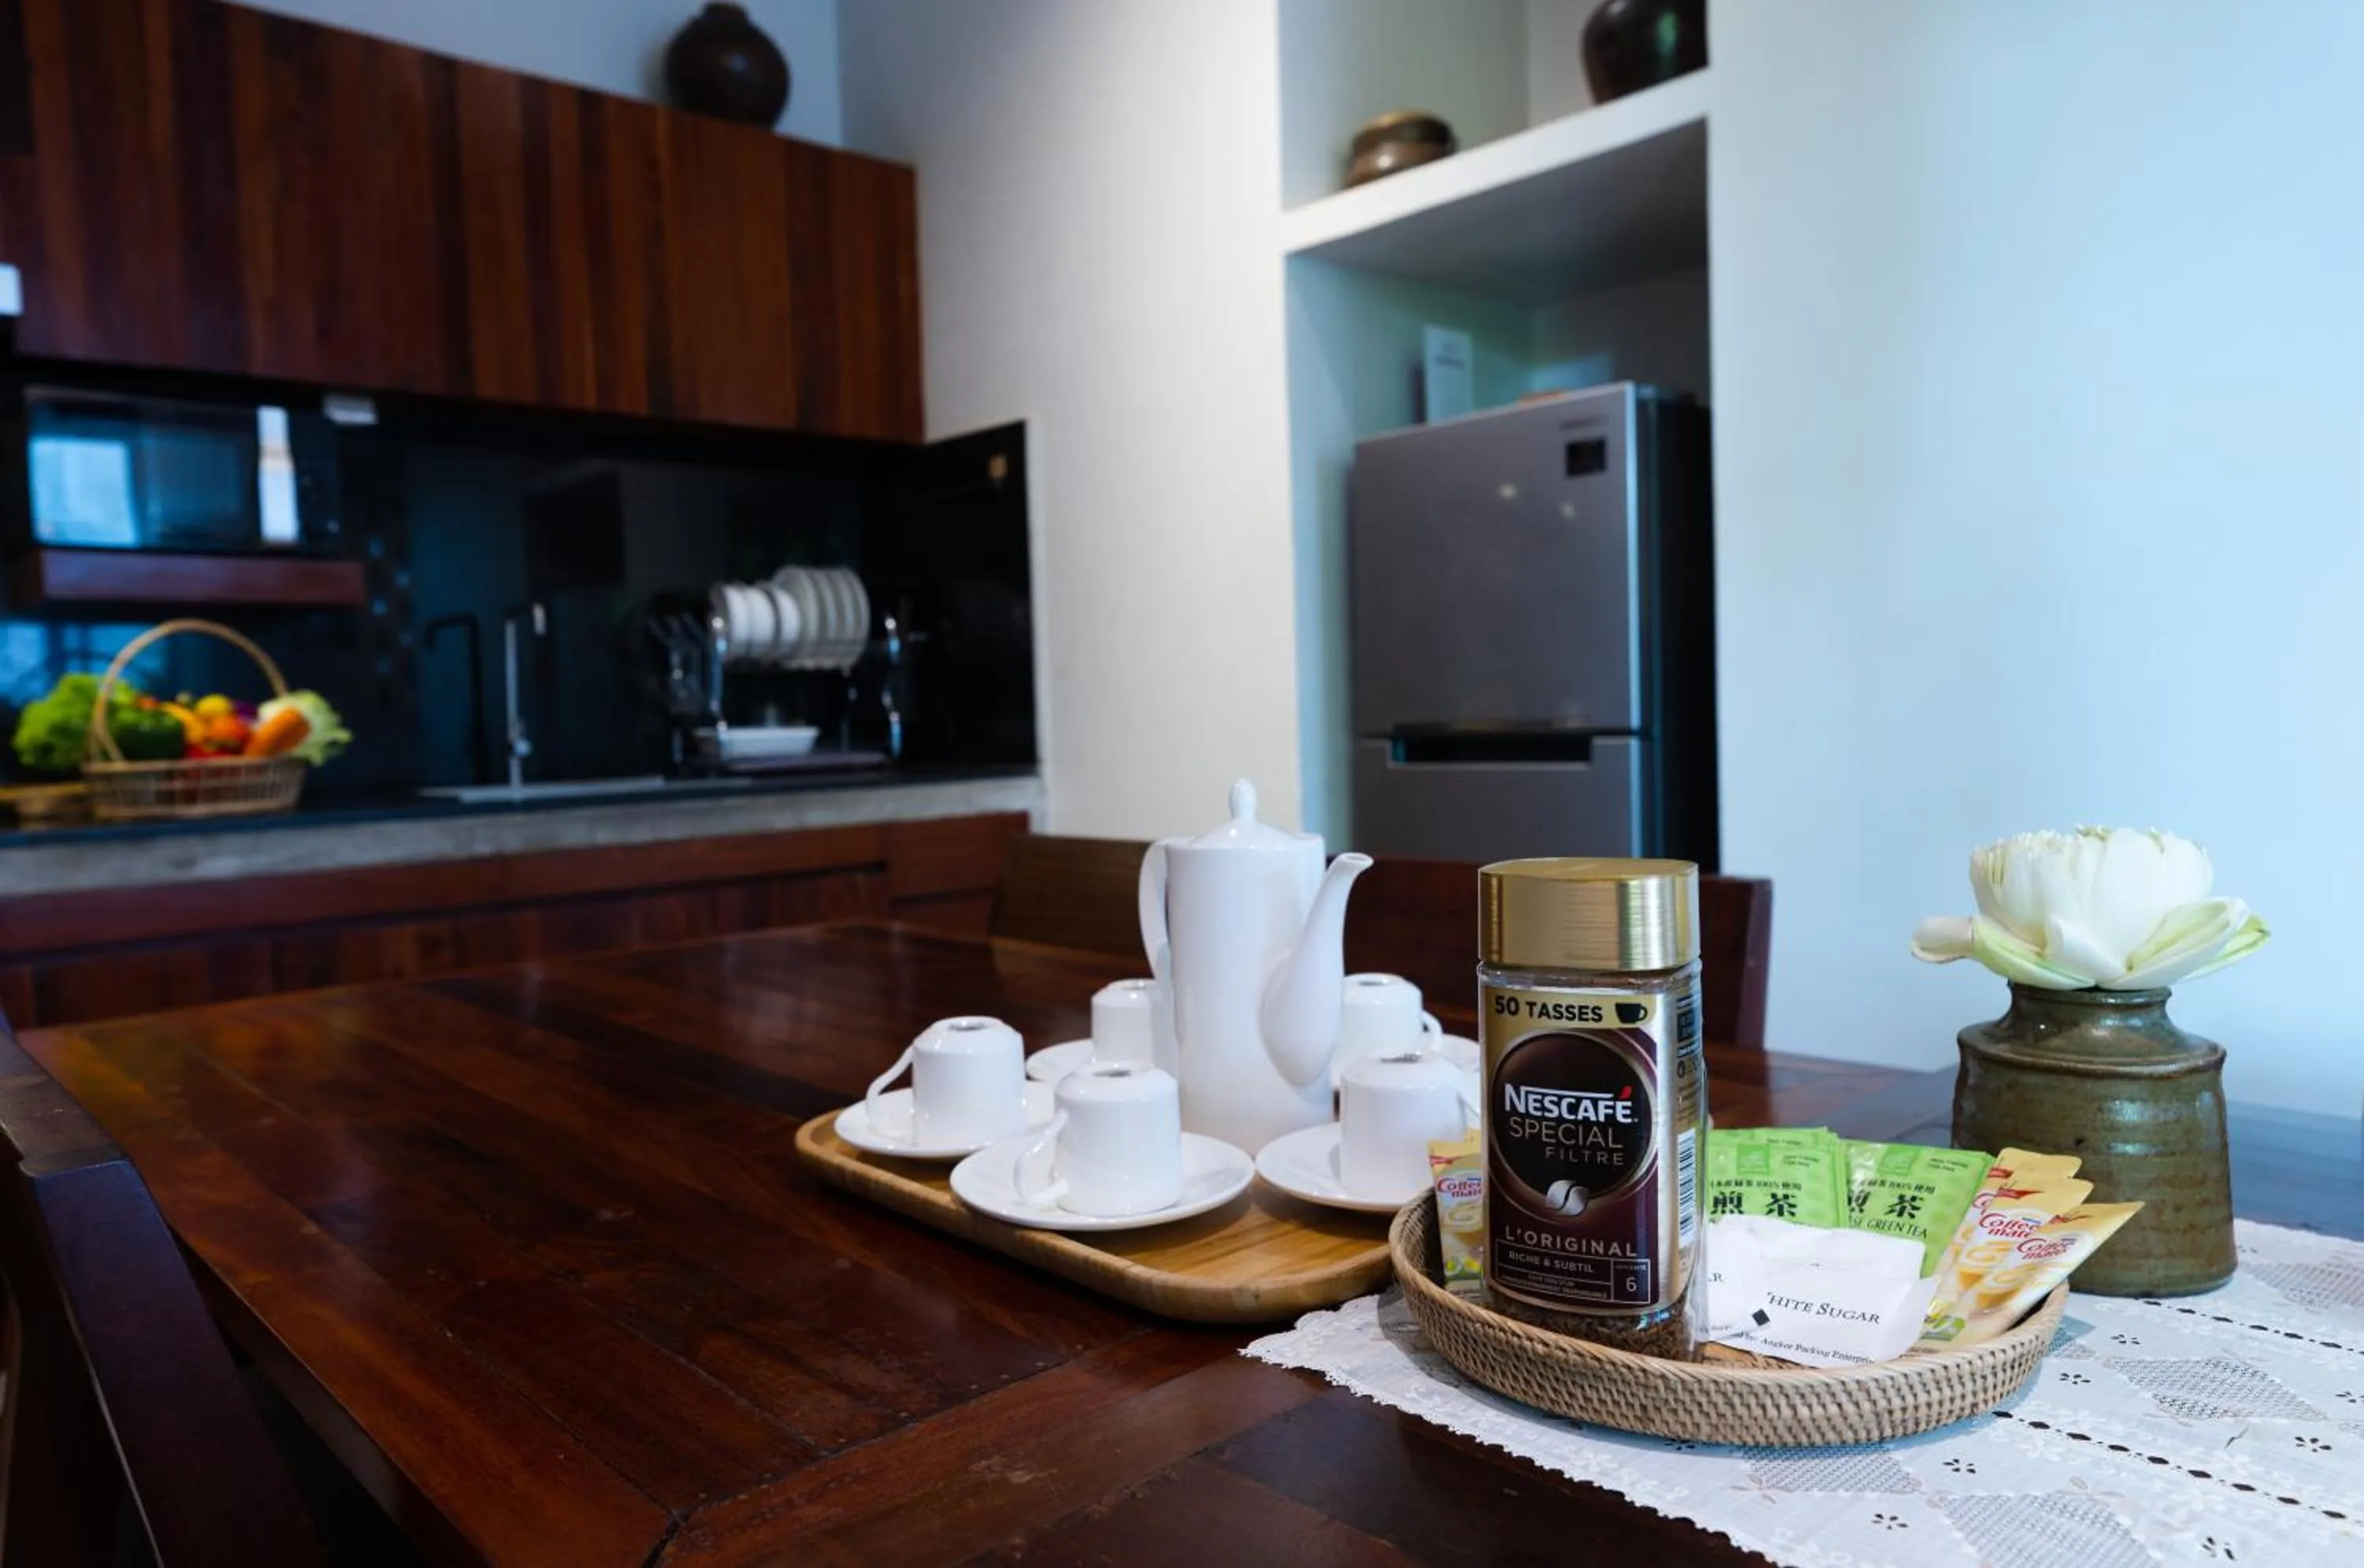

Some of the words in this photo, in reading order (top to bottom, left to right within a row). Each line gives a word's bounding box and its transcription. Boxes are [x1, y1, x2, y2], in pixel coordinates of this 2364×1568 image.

[1494, 994, 1520, 1016] 50
[1526, 1001, 1604, 1023] TASSES
[1504, 1083, 1634, 1123] NESCAFÉ
[1509, 1116, 1624, 1148] SPECIAL
[1544, 1146, 1626, 1165] FILTRE
[1867, 1219, 1905, 1233] GREEN
[1906, 1223, 1928, 1239] TEA
[1504, 1224, 1638, 1258] L'ORIGINAL
[1508, 1250, 1540, 1265] RICHE
[1553, 1259, 1595, 1273] SUBTIL
[1625, 1276, 1637, 1292] 6
[1767, 1291, 1813, 1313] HITE
[1794, 1343, 1831, 1358] Packing
